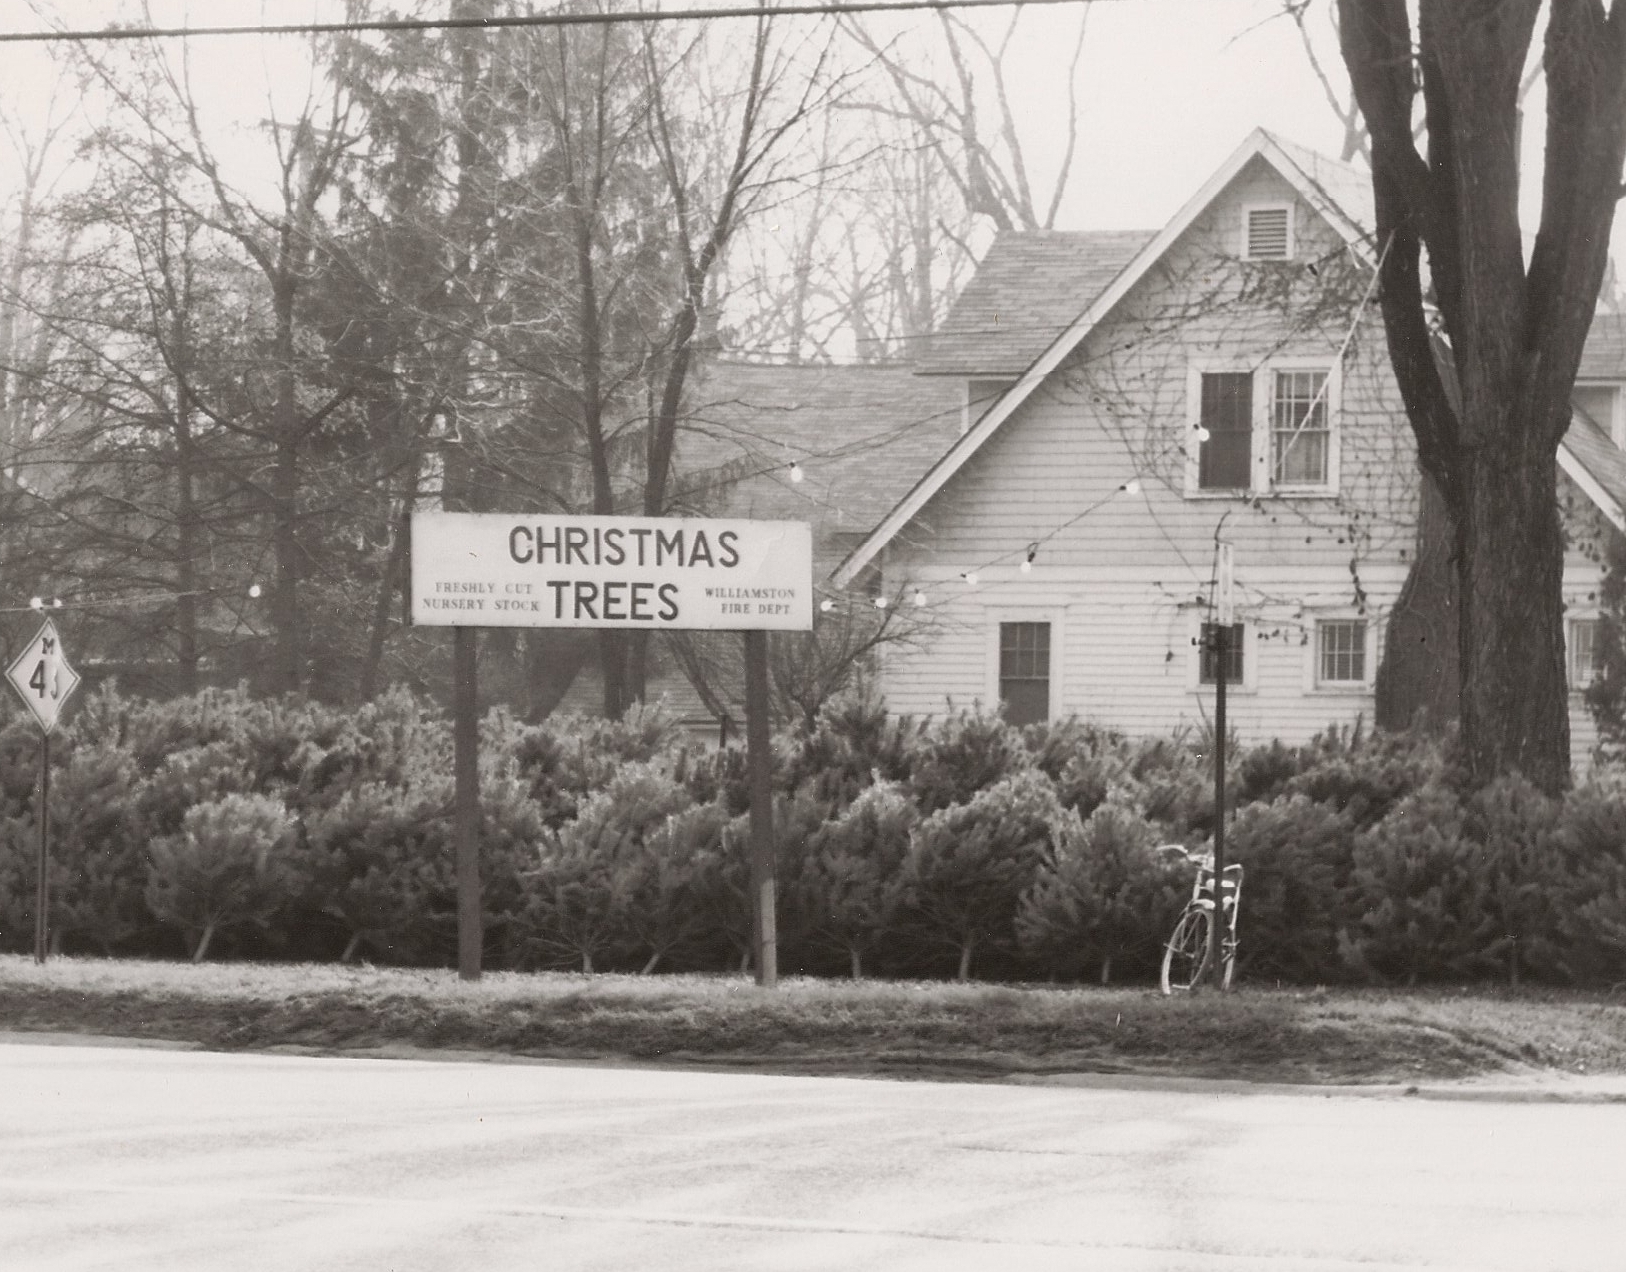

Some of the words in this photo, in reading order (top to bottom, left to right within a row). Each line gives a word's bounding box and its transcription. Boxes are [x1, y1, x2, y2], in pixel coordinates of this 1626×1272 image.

[509, 526, 739, 568] CHRISTMAS
[435, 582, 495, 594] FRESHLY
[505, 583, 533, 595] CUT
[705, 587, 795, 599] WILLIAMSTON
[422, 598, 484, 610] NURSERY
[494, 600, 540, 612] STOCK
[547, 580, 680, 621] TREES
[721, 603, 750, 614] FIRE
[758, 603, 790, 615] DEPT
[42, 637, 55, 655] M
